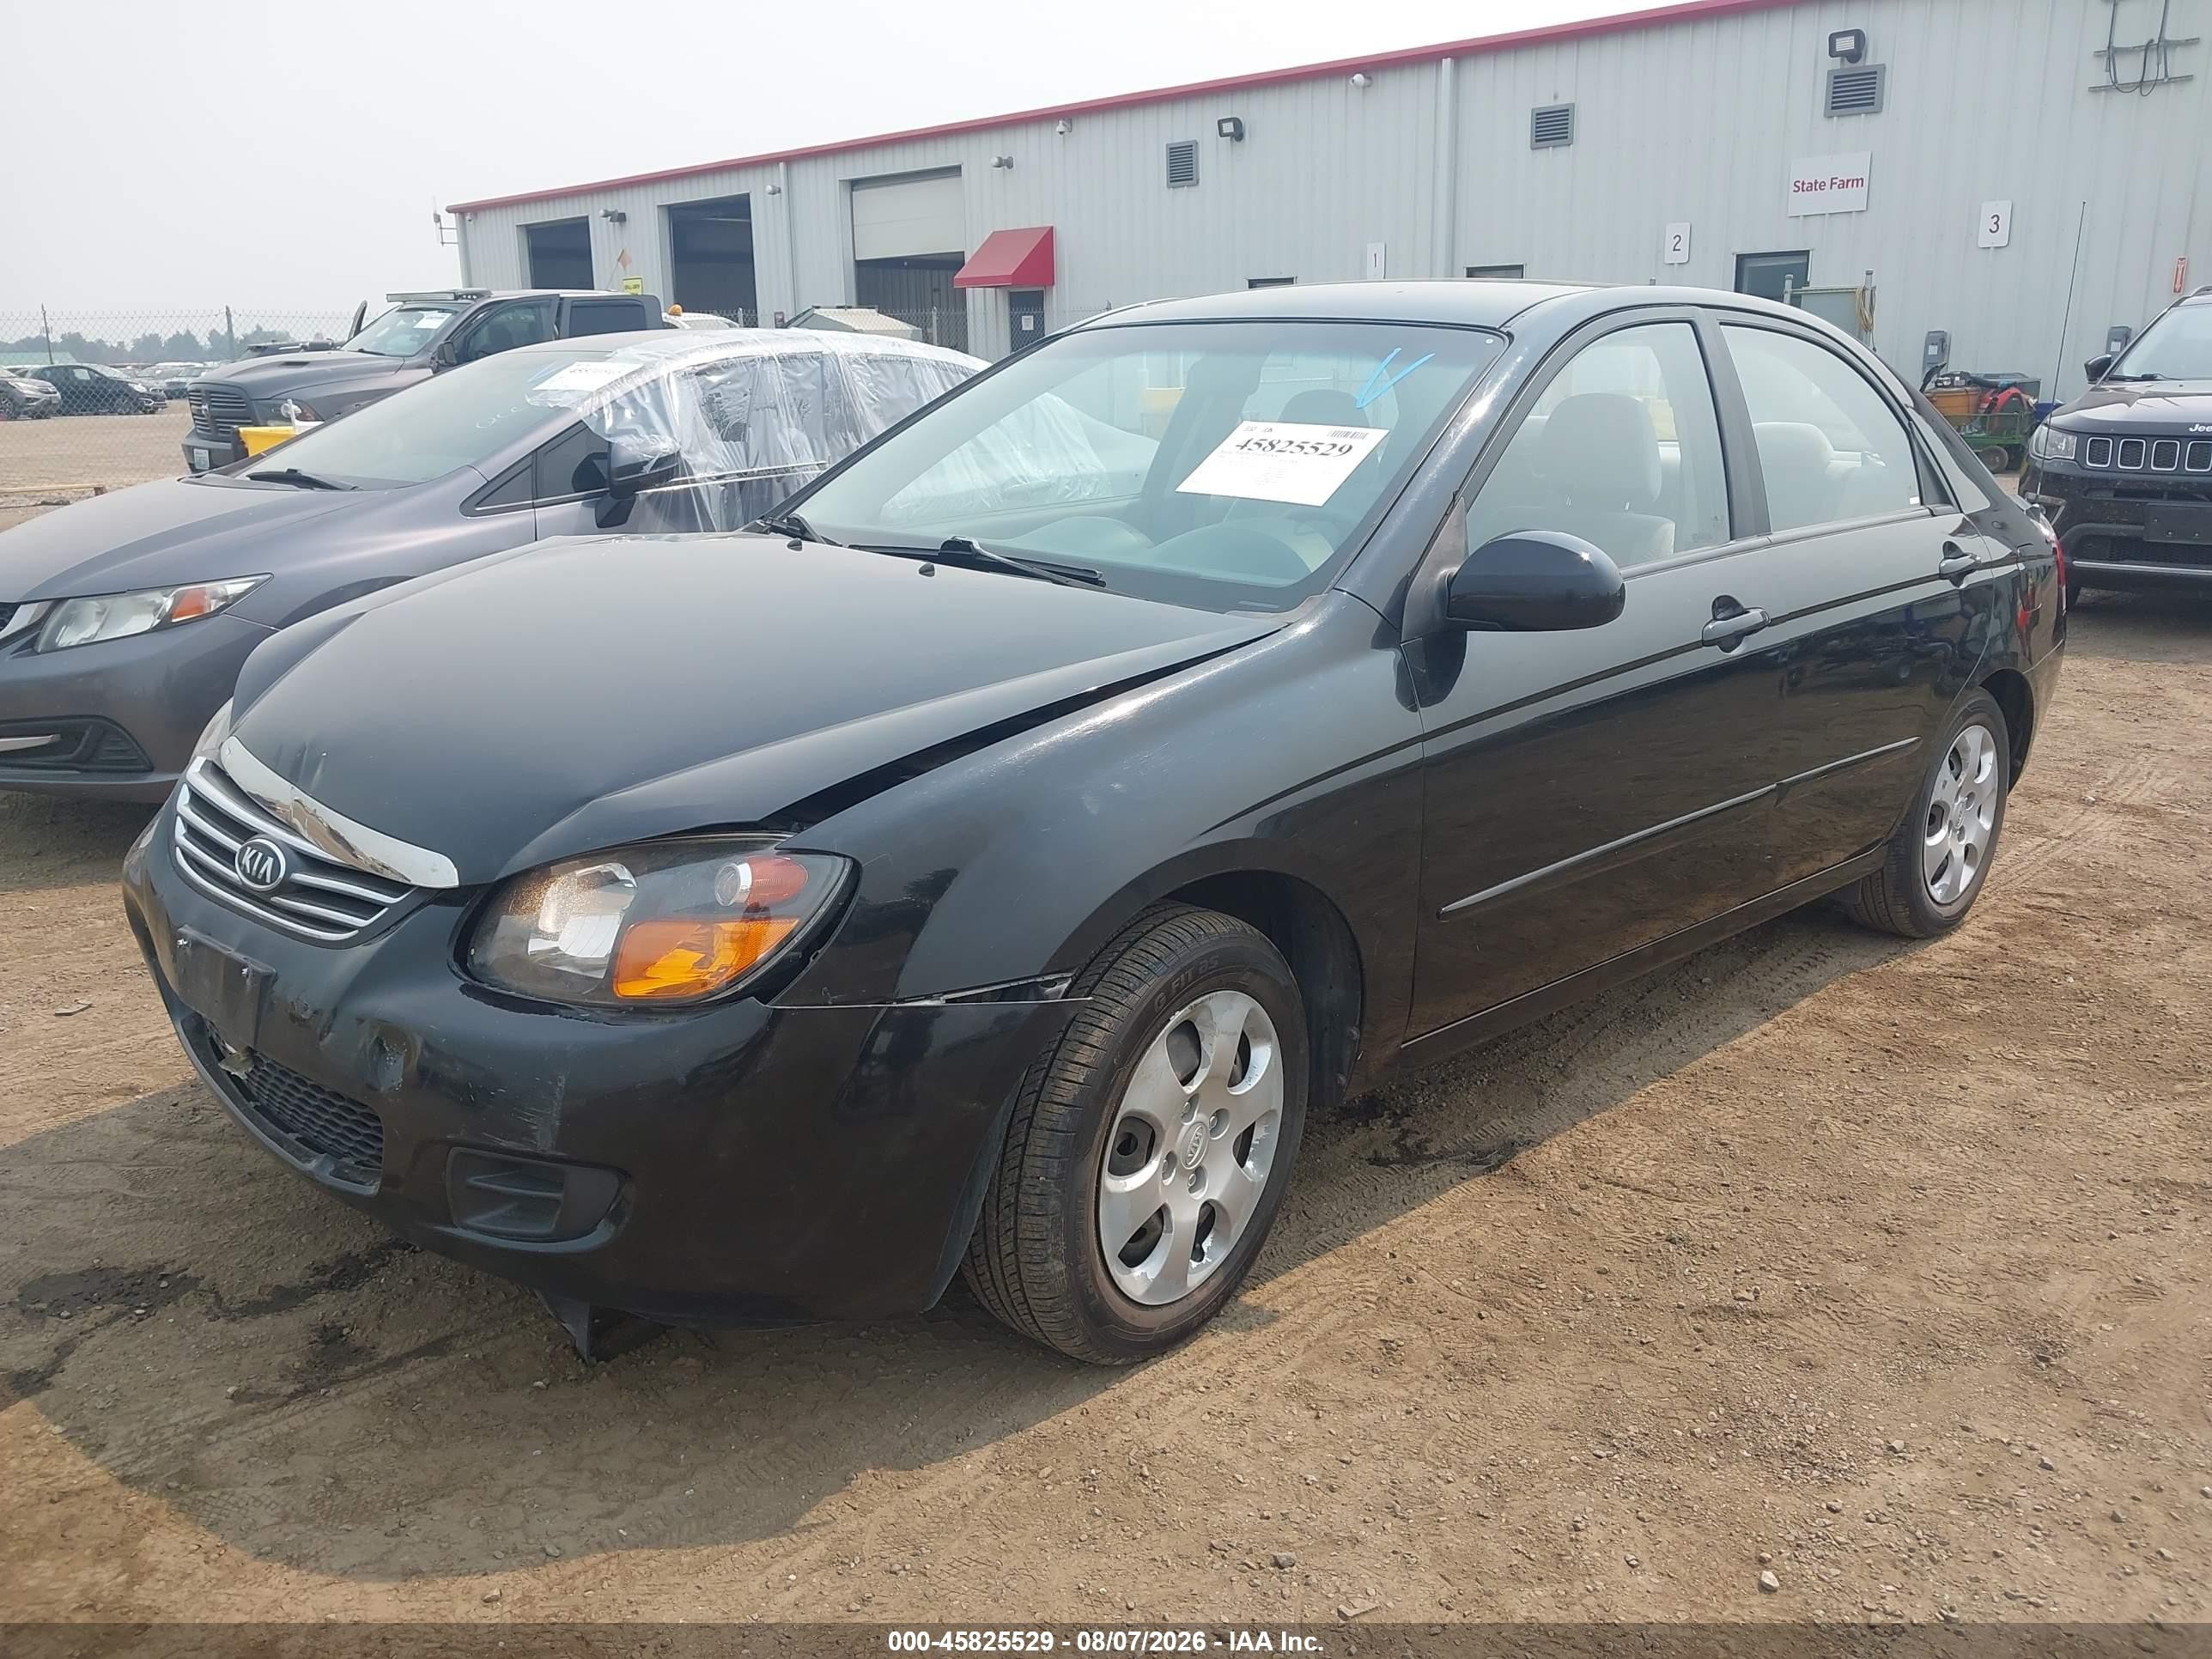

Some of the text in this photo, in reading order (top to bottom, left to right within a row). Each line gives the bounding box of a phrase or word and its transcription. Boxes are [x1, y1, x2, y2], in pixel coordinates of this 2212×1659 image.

[1792, 177, 1864, 193] State Farm
[1989, 214, 2000, 234] 3
[1673, 234, 1681, 252] 2
[1235, 438, 1353, 458] 45825529
[240, 846, 274, 884] KIA
